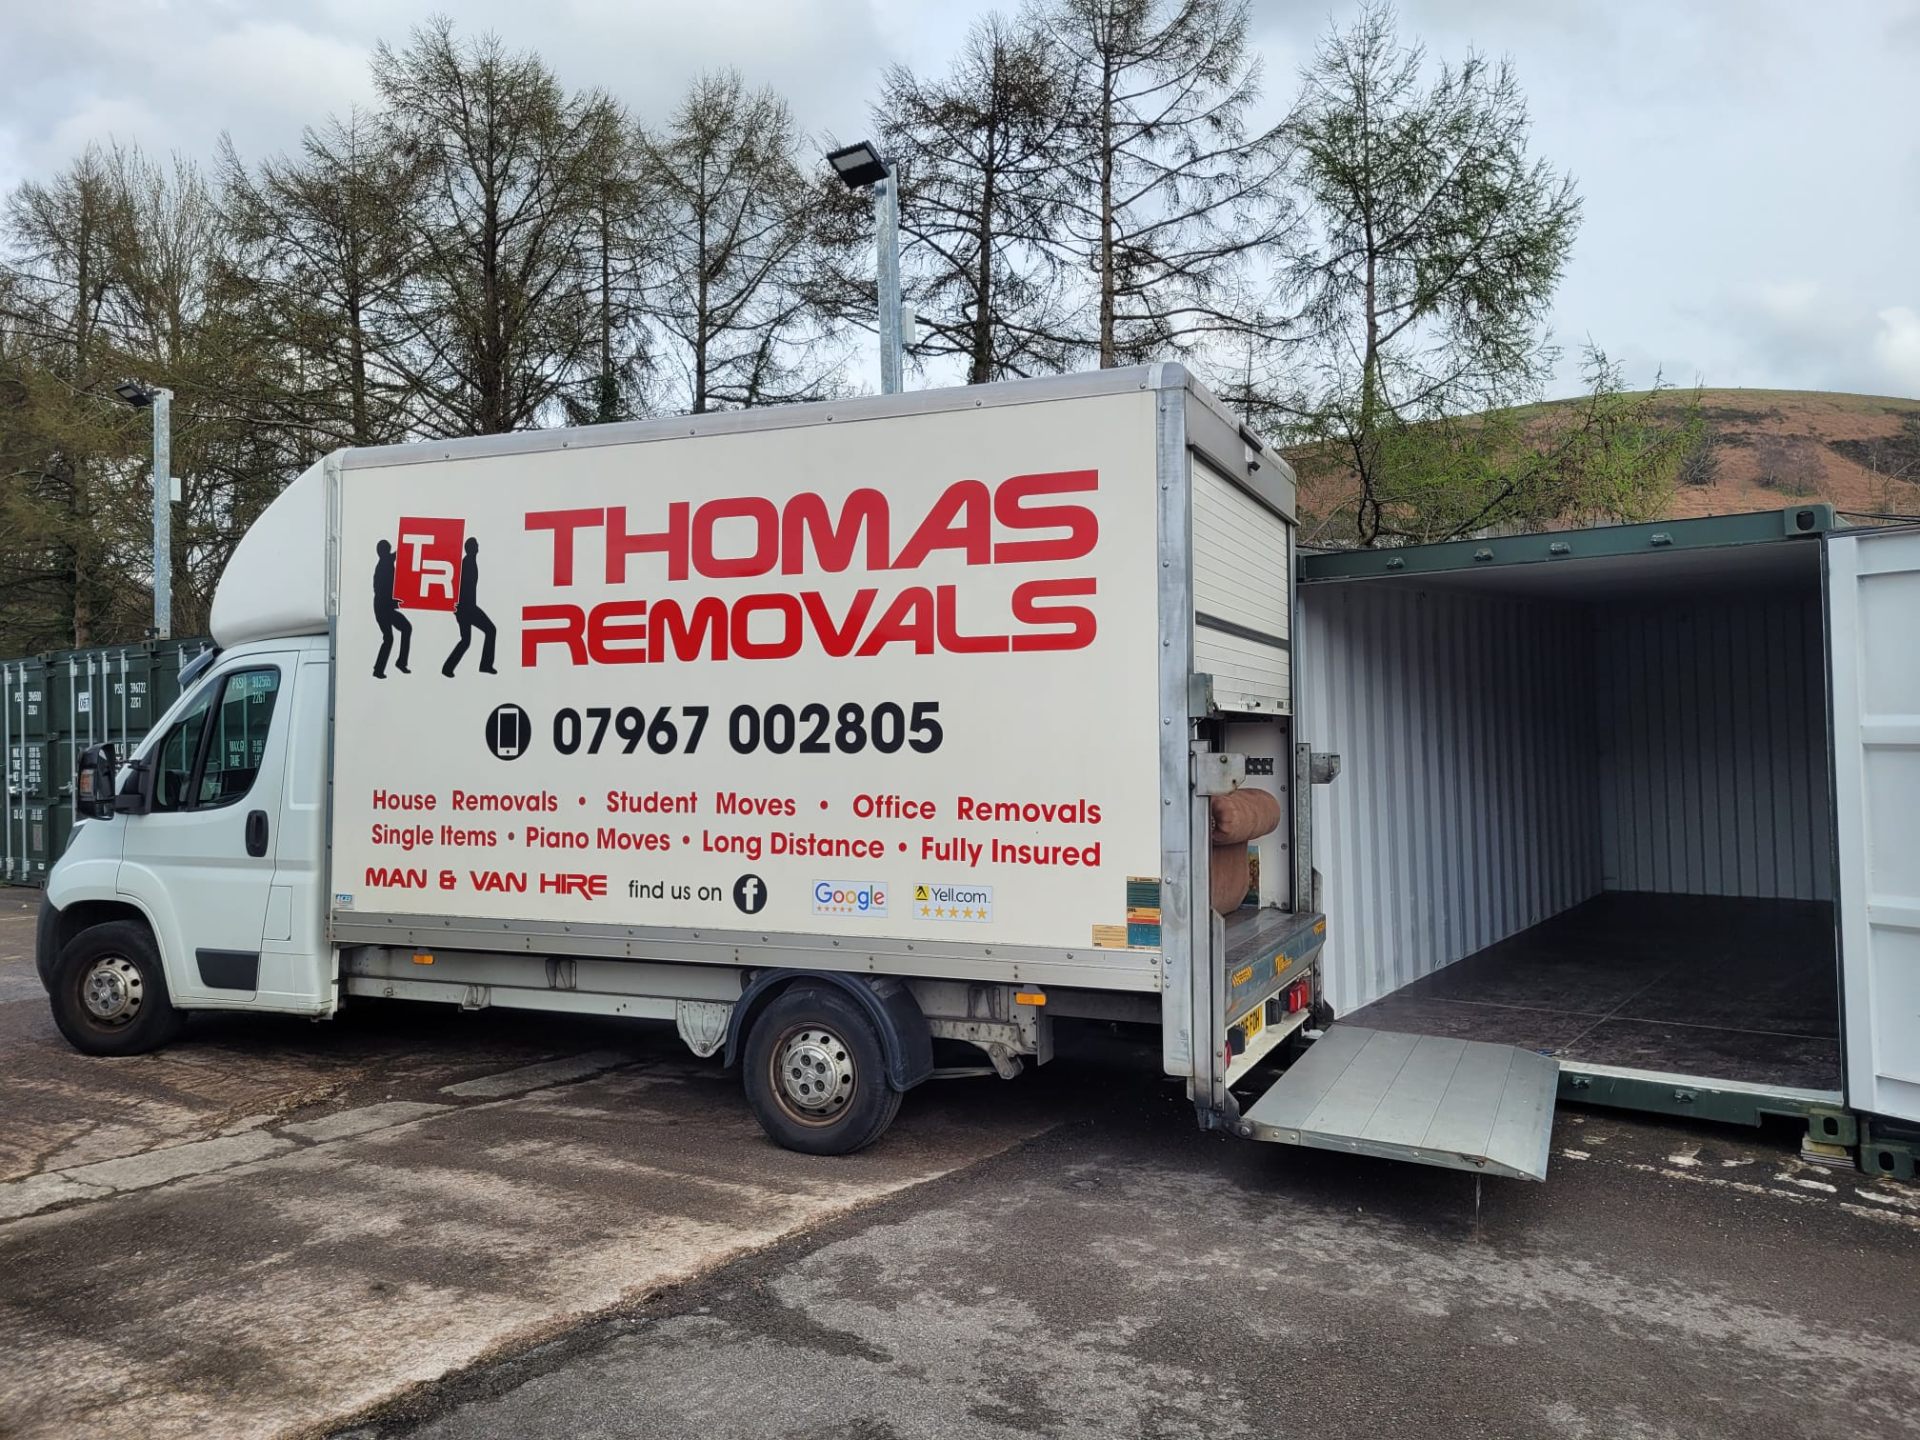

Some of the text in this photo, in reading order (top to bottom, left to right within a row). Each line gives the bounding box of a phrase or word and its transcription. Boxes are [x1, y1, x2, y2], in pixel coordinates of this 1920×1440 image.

[524, 469, 1100, 588] THOMAS
[521, 577, 1098, 668] REMOVALS
[554, 702, 943, 755] 07967 002805
[372, 789, 1102, 825] House Removals Student Moves Office Removals
[372, 824, 1102, 868] Single Items Piano Moves Long Distance Fully Insured
[365, 866, 428, 889] MAN
[439, 870, 457, 891] &
[469, 871, 528, 894] VAN
[539, 873, 608, 900] HIRE
[628, 880, 664, 899] find
[671, 886, 691, 900] us
[697, 886, 722, 902] on
[815, 882, 885, 911] Google
[931, 887, 988, 904] Yell.com
